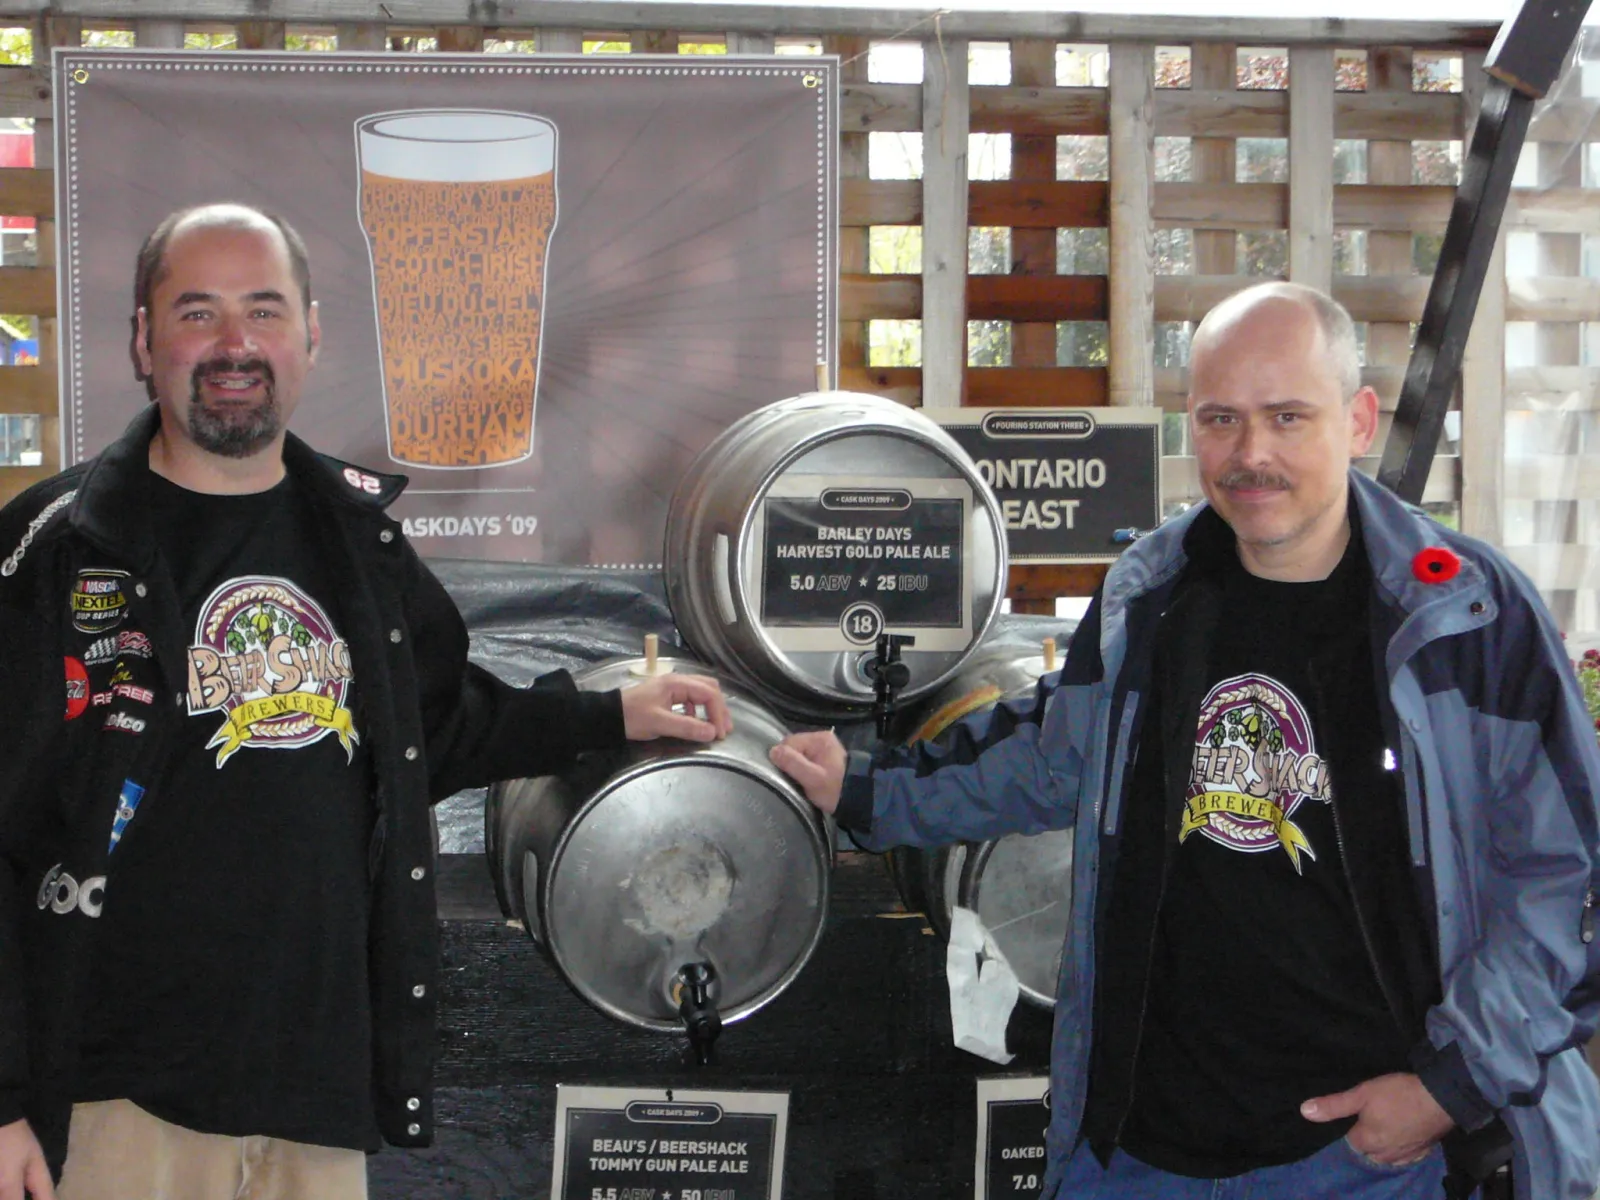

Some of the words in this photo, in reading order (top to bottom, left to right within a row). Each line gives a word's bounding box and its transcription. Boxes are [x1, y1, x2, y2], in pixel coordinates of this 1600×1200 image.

[386, 357, 535, 384] MUSKOKA
[391, 414, 532, 442] DURHAM
[1029, 421, 1059, 430] STATION
[1060, 421, 1084, 430] THREE
[975, 458, 1106, 489] ONTARIO
[1002, 500, 1080, 530] EAST
[402, 516, 501, 537] ASKDAYS
[505, 514, 538, 536] '09
[817, 527, 873, 541] BARLEY
[876, 527, 912, 541] DAYS
[776, 545, 843, 559] HARVEST
[845, 545, 883, 559] GOLD
[885, 545, 921, 559] PALE
[923, 545, 951, 559] ALE
[83, 579, 121, 594] NASCA
[790, 575, 815, 591] 5.0
[816, 575, 852, 591] ABV
[877, 575, 896, 591] 25
[898, 575, 928, 591] IBU
[75, 594, 122, 609] NEXTEL
[852, 615, 873, 634] 18
[592, 1139, 647, 1153] BEAU'S
[659, 1140, 748, 1156] BEERSHACK
[1002, 1146, 1045, 1160] OAKED
[589, 1158, 644, 1172] TOMMY
[646, 1158, 677, 1173] GUN
[680, 1159, 717, 1173] PALE
[719, 1160, 749, 1174] ALE
[1012, 1174, 1038, 1190] 7.0
[592, 1188, 617, 1200] 5.5
[681, 1189, 701, 1200] 50
